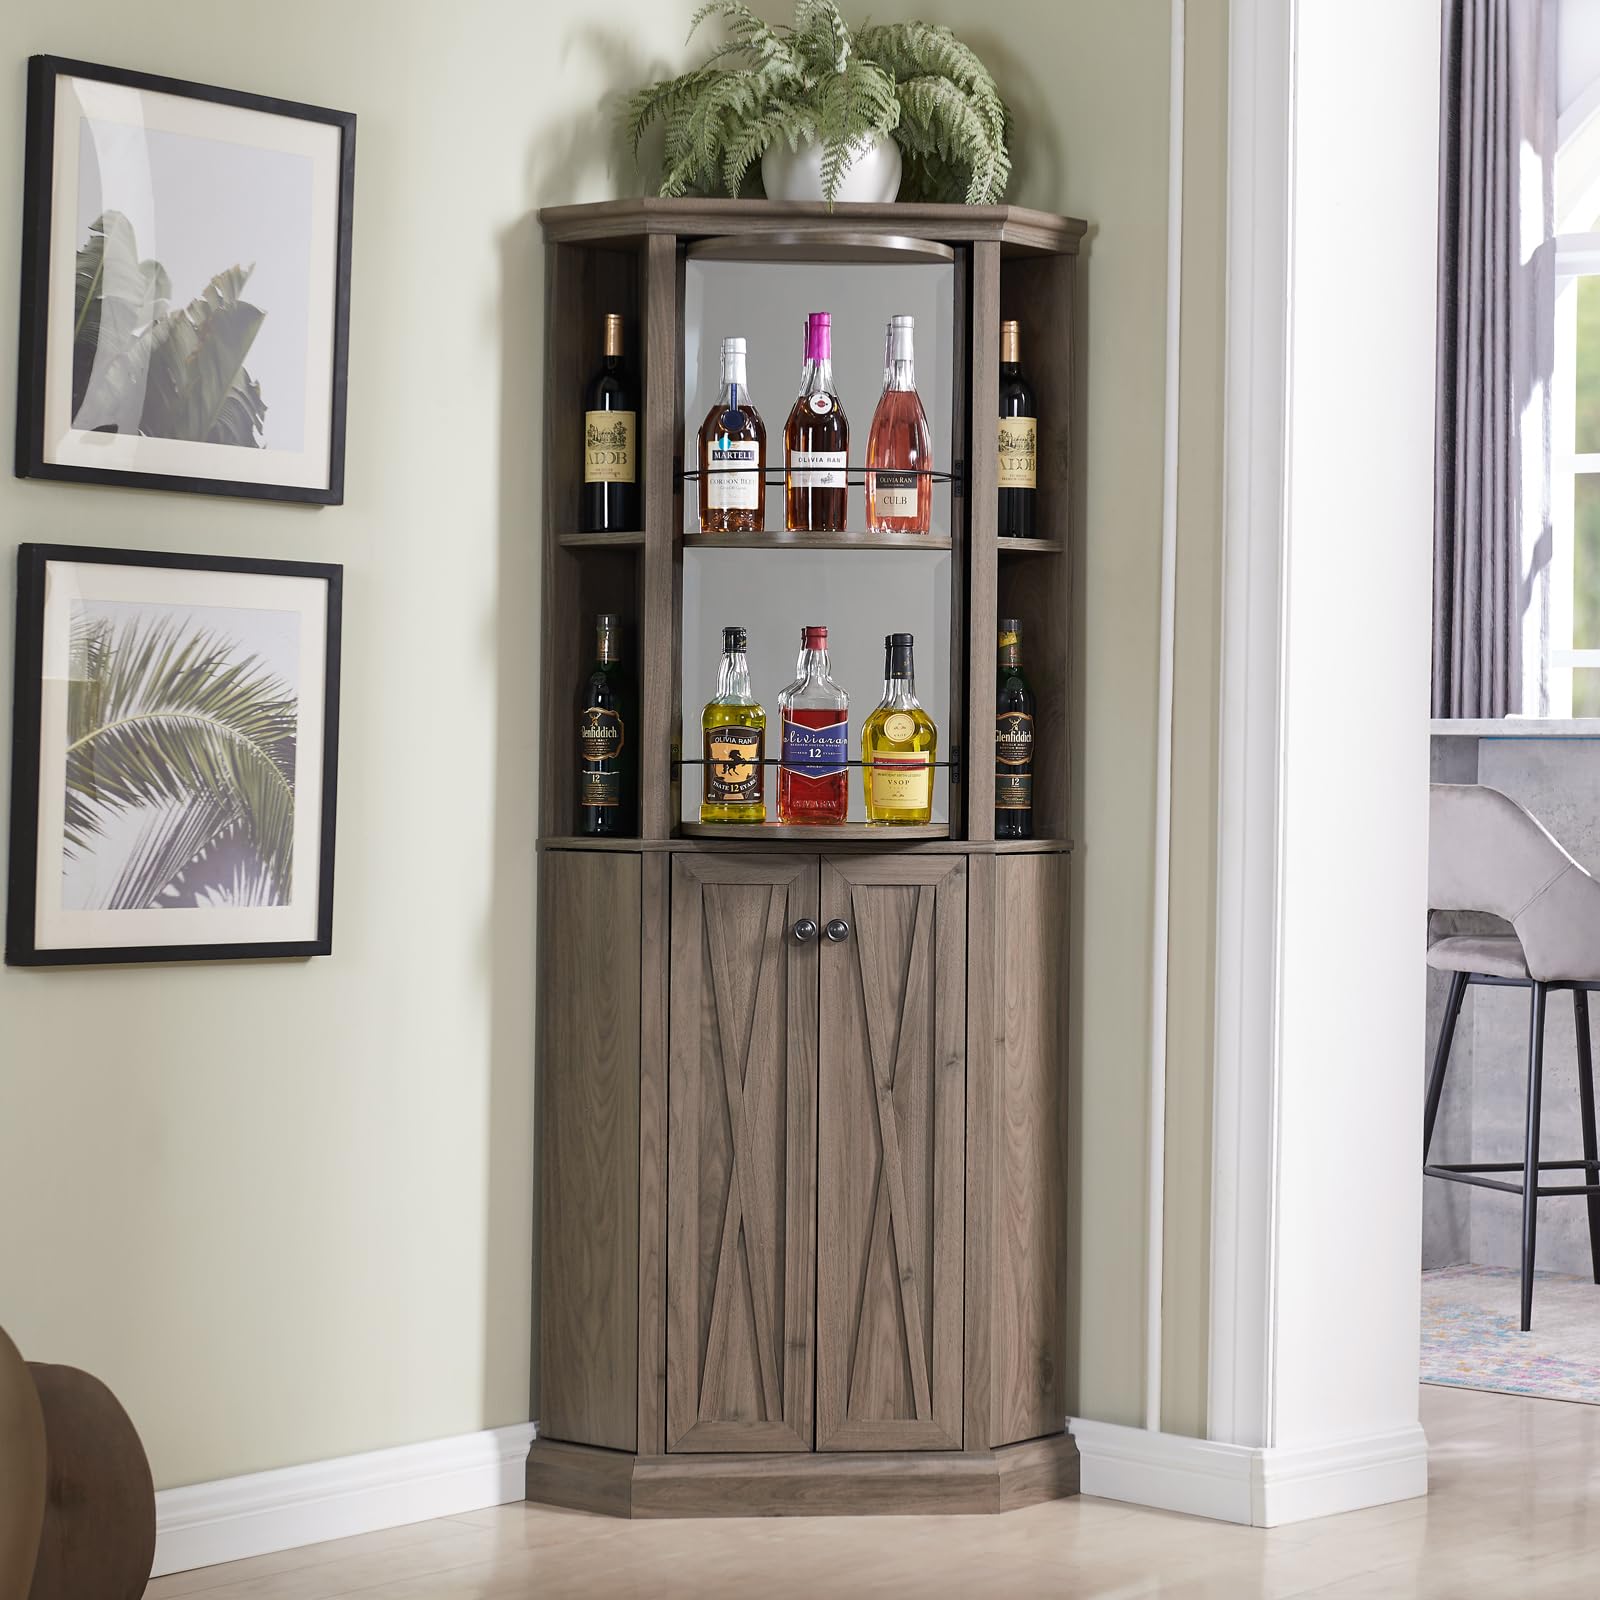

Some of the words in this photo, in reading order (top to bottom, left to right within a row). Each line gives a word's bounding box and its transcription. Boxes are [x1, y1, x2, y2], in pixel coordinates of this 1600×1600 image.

[713, 451, 753, 460] MARTELL
[899, 476, 913, 484] RAN
[883, 496, 908, 505] CULB
[714, 736, 737, 744] OLIVIA
[738, 737, 752, 745] RAN
[995, 729, 1032, 743] Glenfiddich
[809, 748, 822, 758] 12
[592, 774, 601, 782] 12
[1011, 777, 1020, 786] 12
[730, 784, 740, 792] 12
